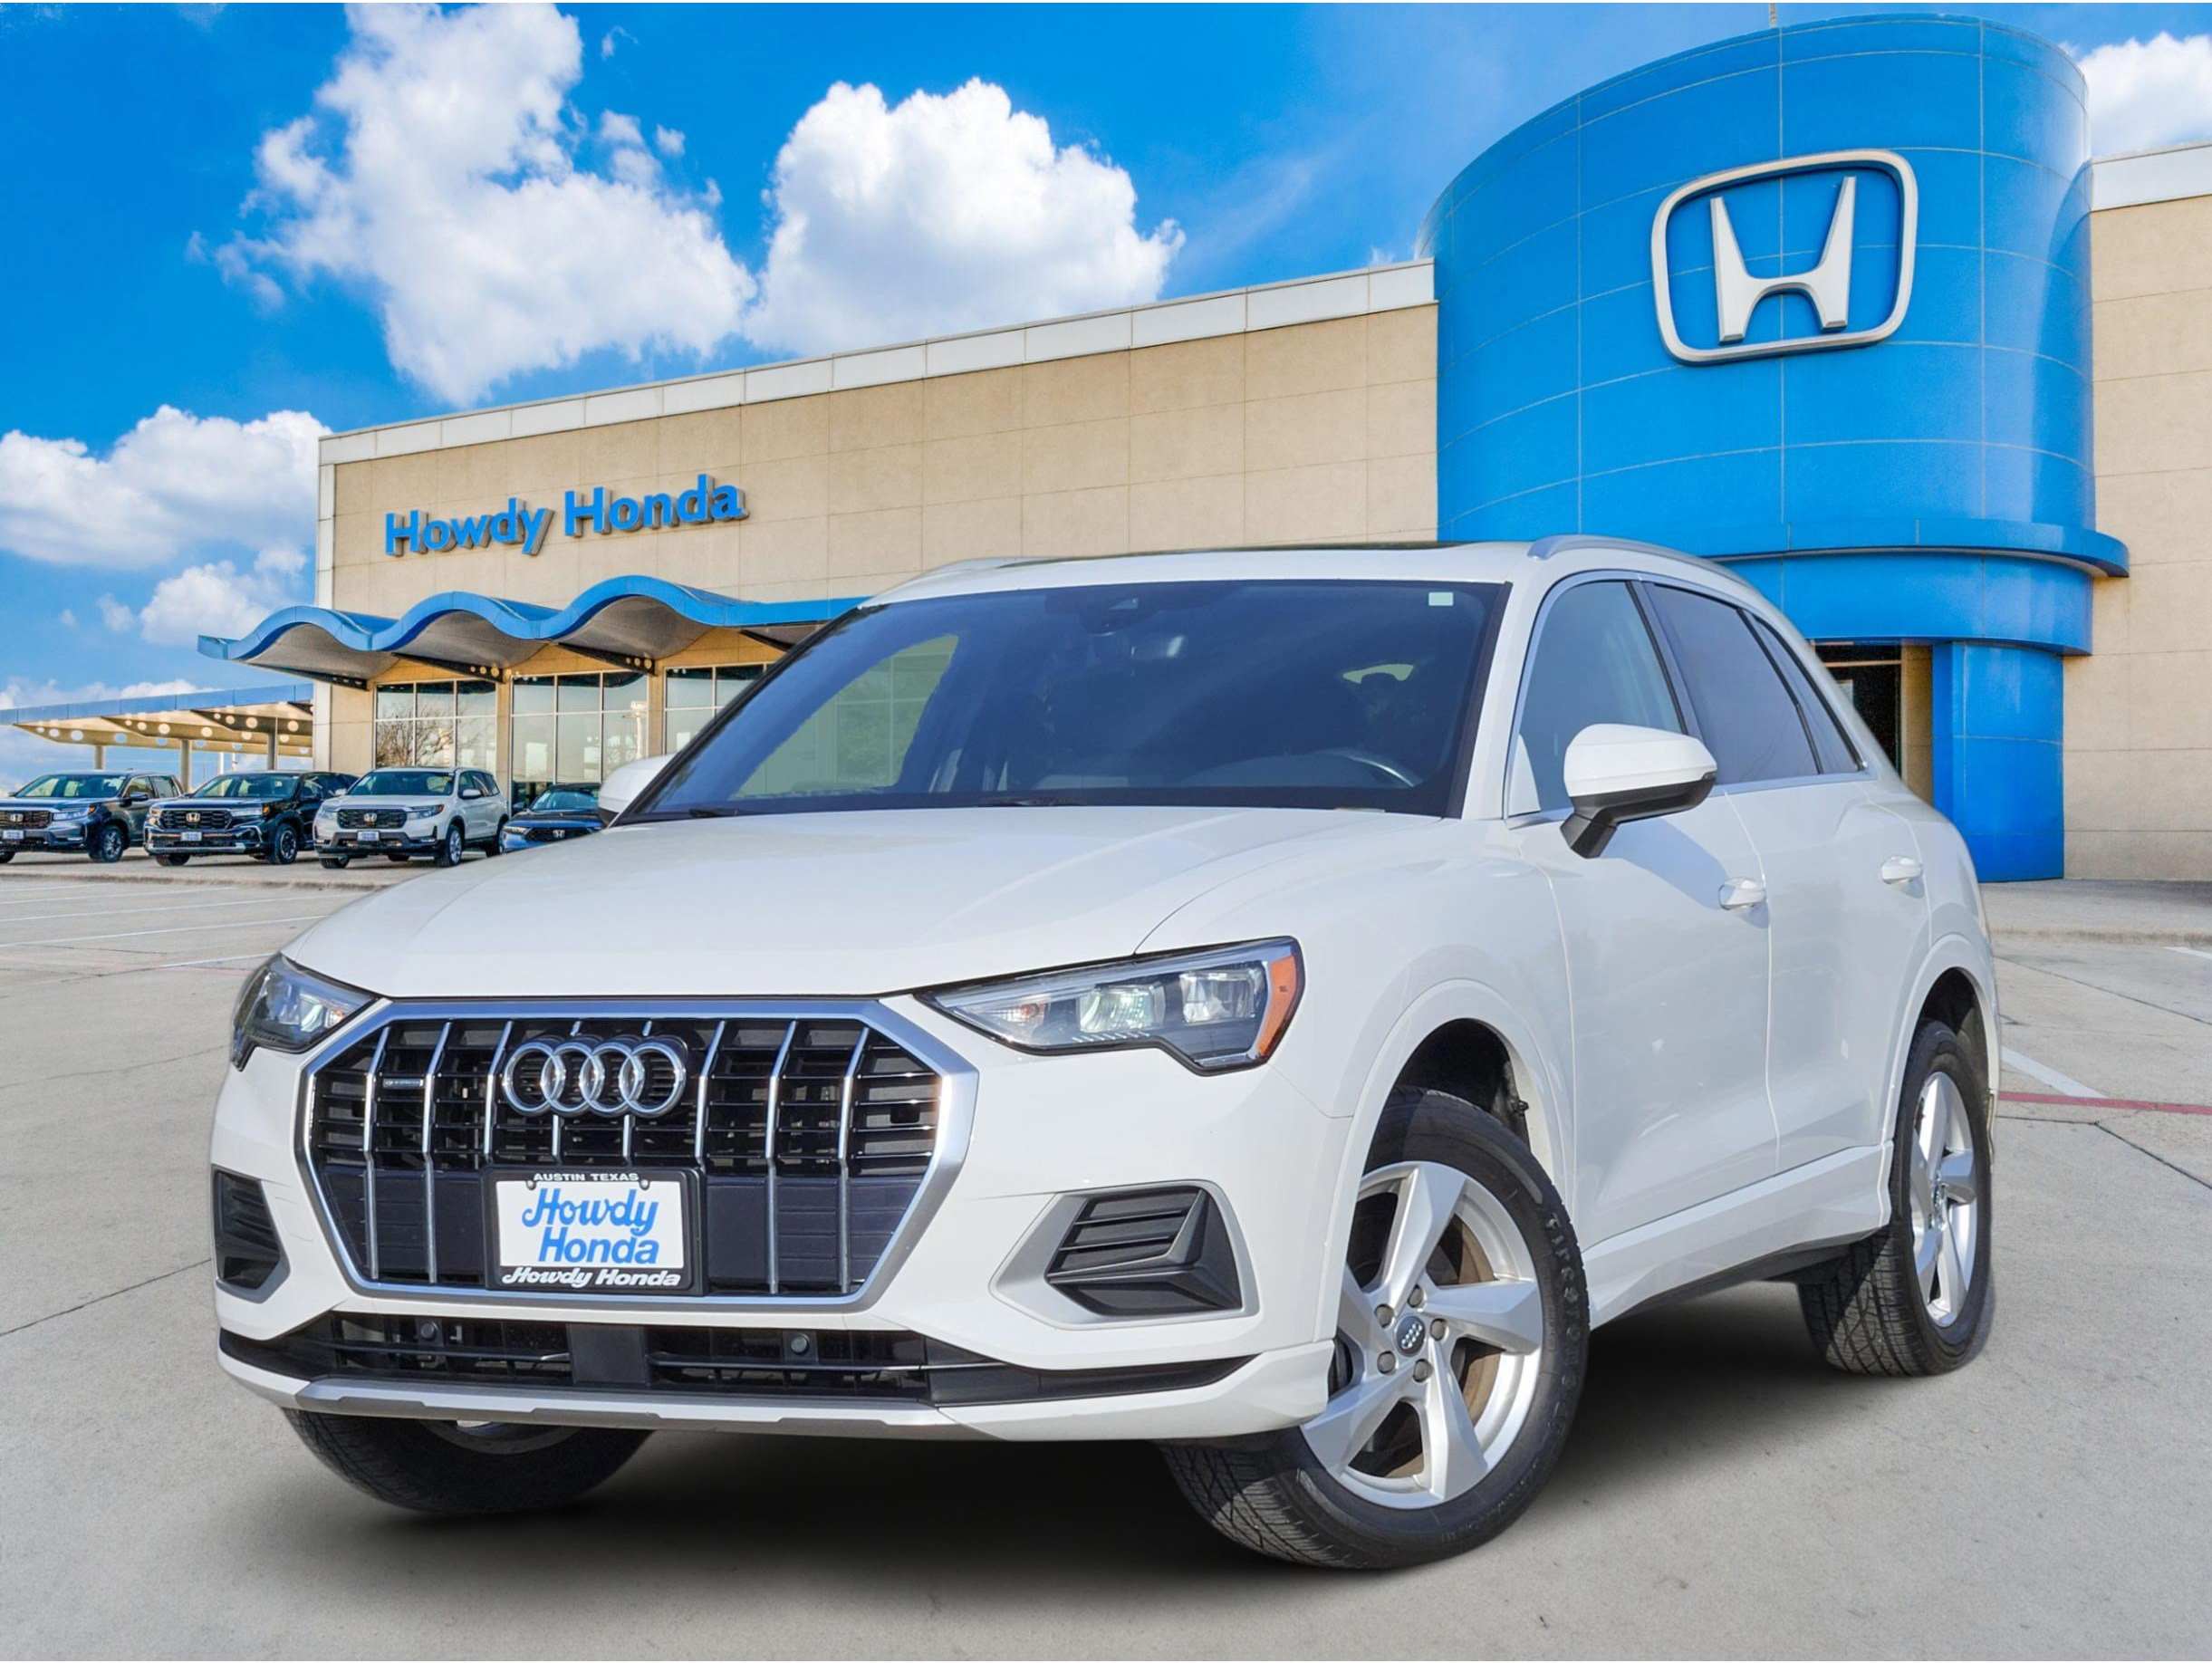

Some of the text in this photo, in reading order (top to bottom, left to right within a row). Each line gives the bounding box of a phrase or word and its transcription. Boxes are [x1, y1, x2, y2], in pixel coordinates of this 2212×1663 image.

[385, 474, 750, 557] Howdy Honda
[533, 1172, 640, 1182] AUSTIN TEXAS
[521, 1187, 659, 1237] Howdy
[538, 1226, 660, 1265] Honda
[501, 1266, 681, 1289] Howdy Honda
